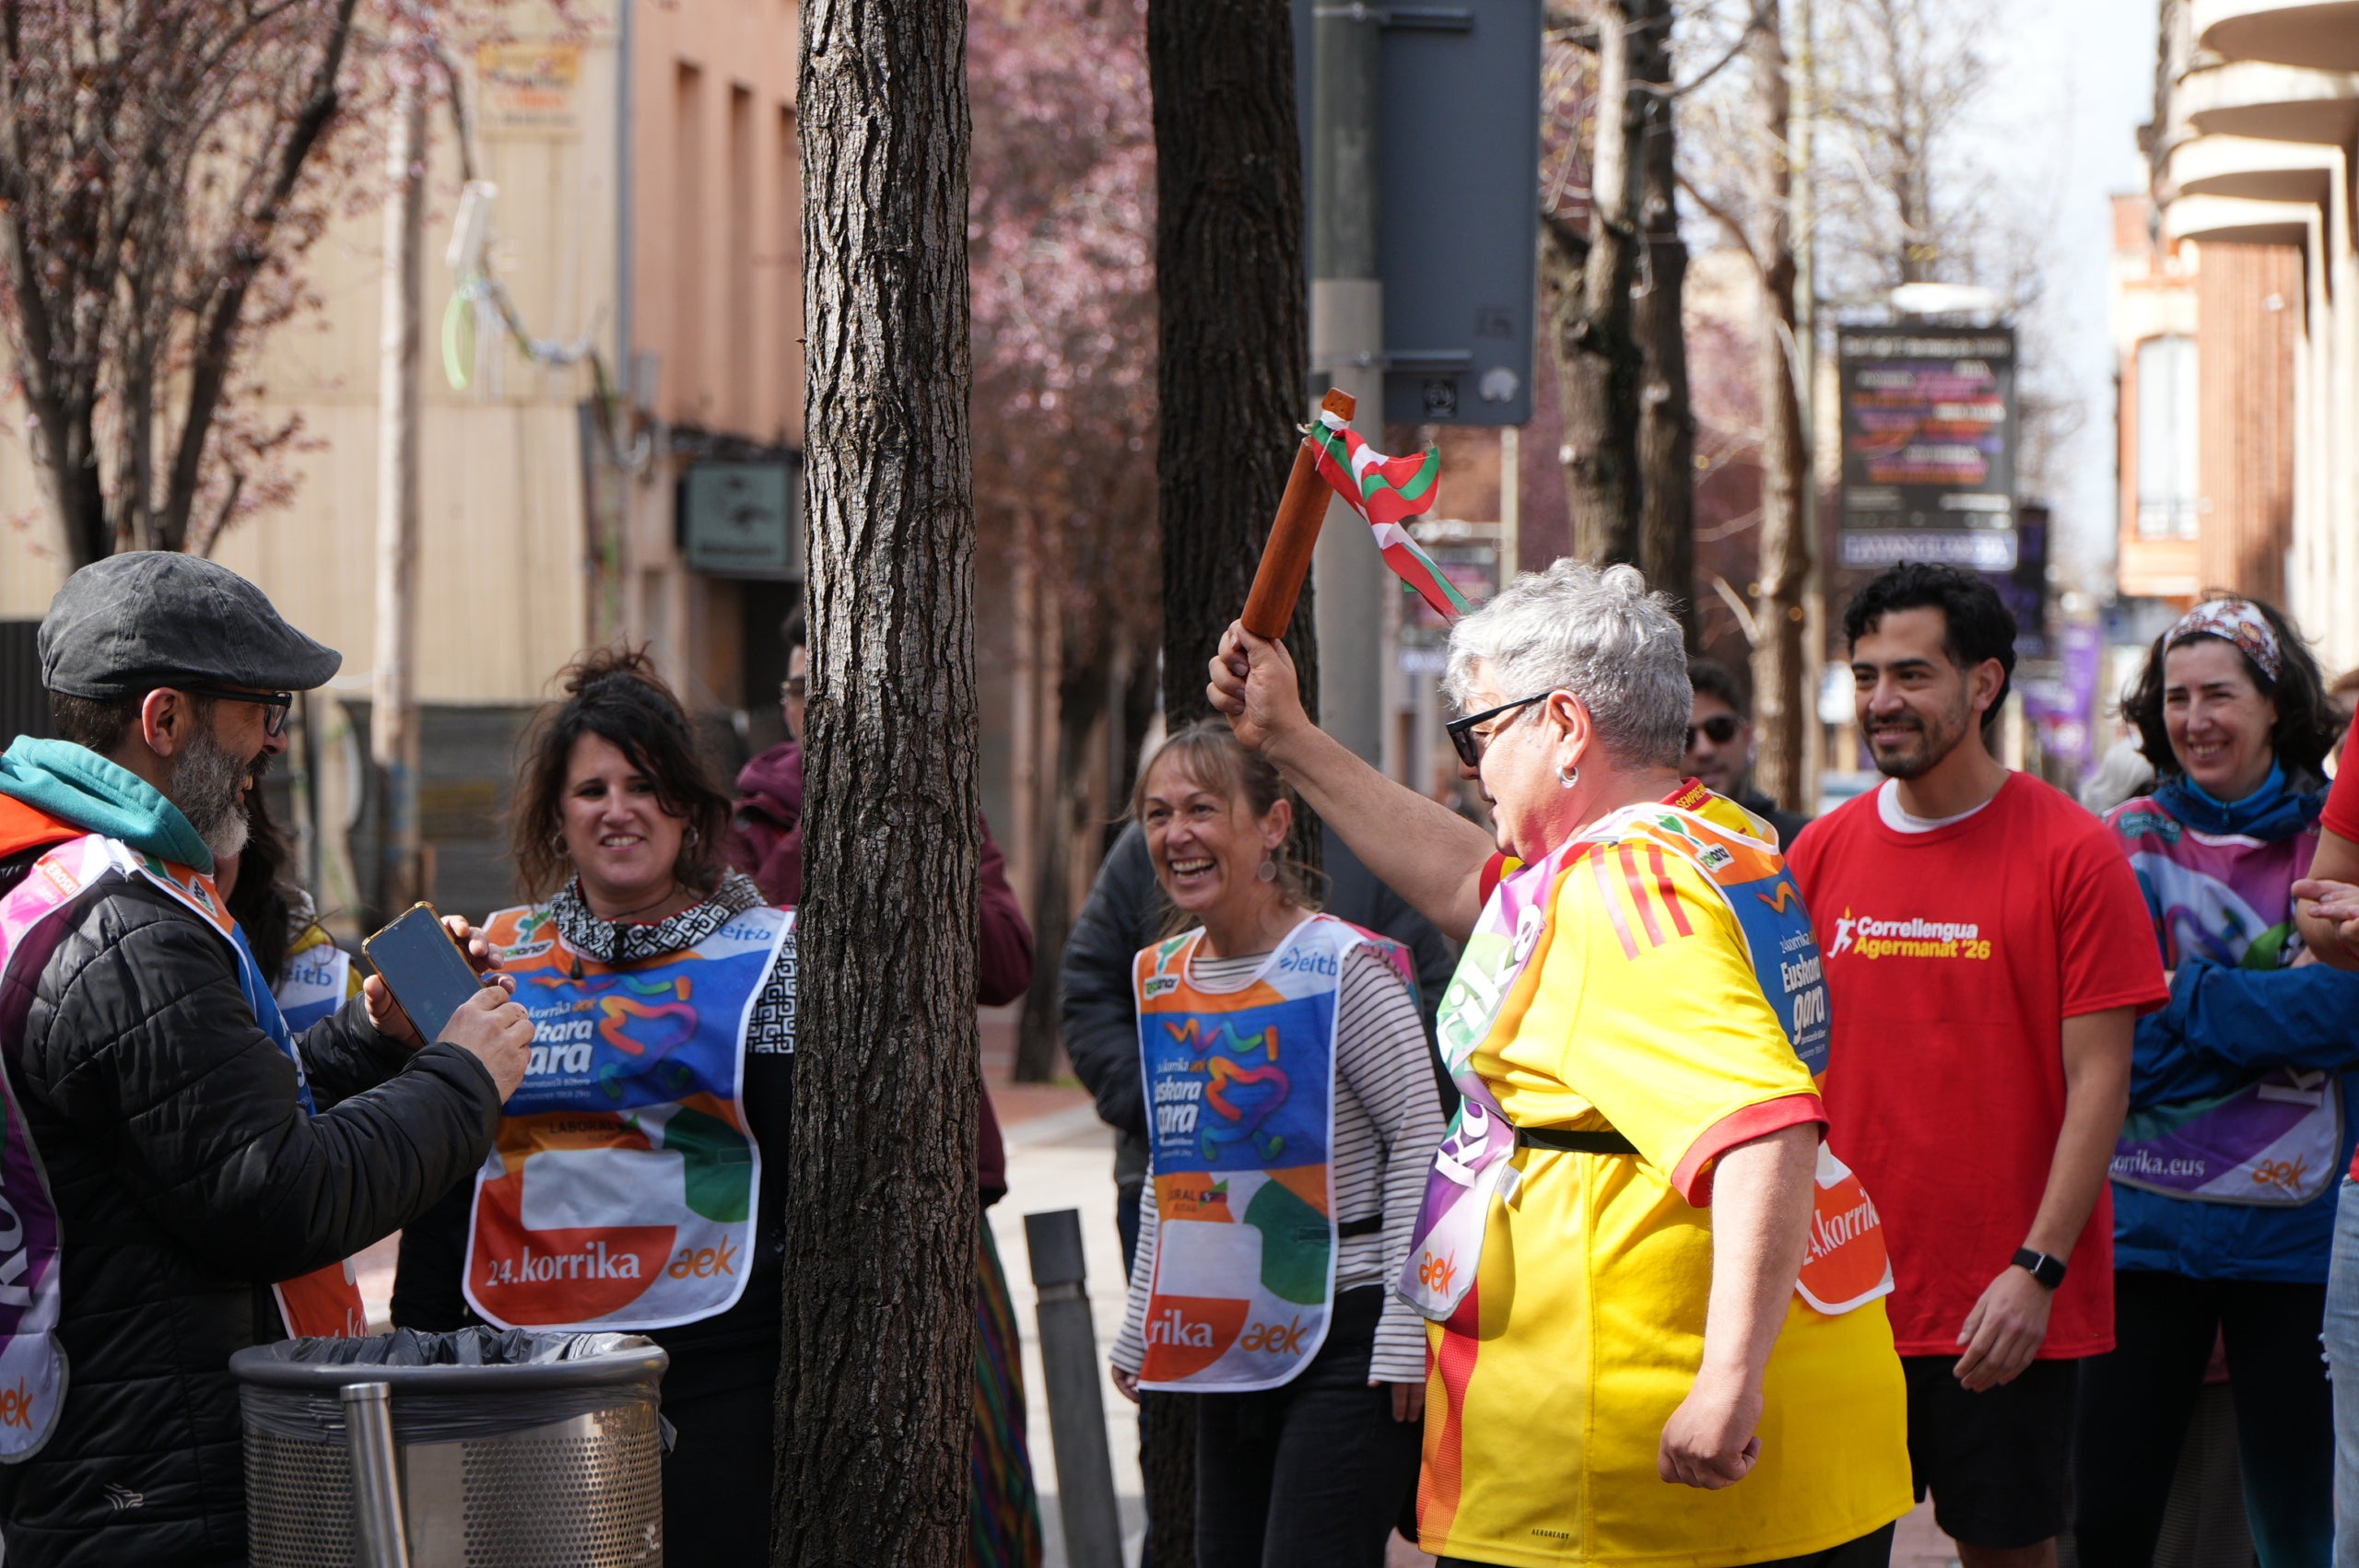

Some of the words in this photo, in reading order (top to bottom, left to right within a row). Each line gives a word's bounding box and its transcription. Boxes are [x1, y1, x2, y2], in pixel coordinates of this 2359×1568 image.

[47, 863, 76, 894] EROSKI
[720, 923, 772, 941] eitb
[1857, 917, 1978, 942] Correllengua
[1853, 936, 1959, 959] Agermanat
[1298, 952, 1337, 976] eitb
[532, 1019, 593, 1043] kara
[1792, 985, 1825, 1046] gara
[524, 1042, 593, 1076] ara
[2111, 1149, 2205, 1176] orrika.eus
[2251, 1153, 2308, 1190] aek
[486, 1242, 640, 1286] 24.korrika
[667, 1234, 737, 1280] aek
[1419, 1249, 1458, 1299] aek
[1240, 1314, 1309, 1356] aek
[0, 1375, 33, 1431] ek
[1531, 1528, 1570, 1539] AEROREADY
